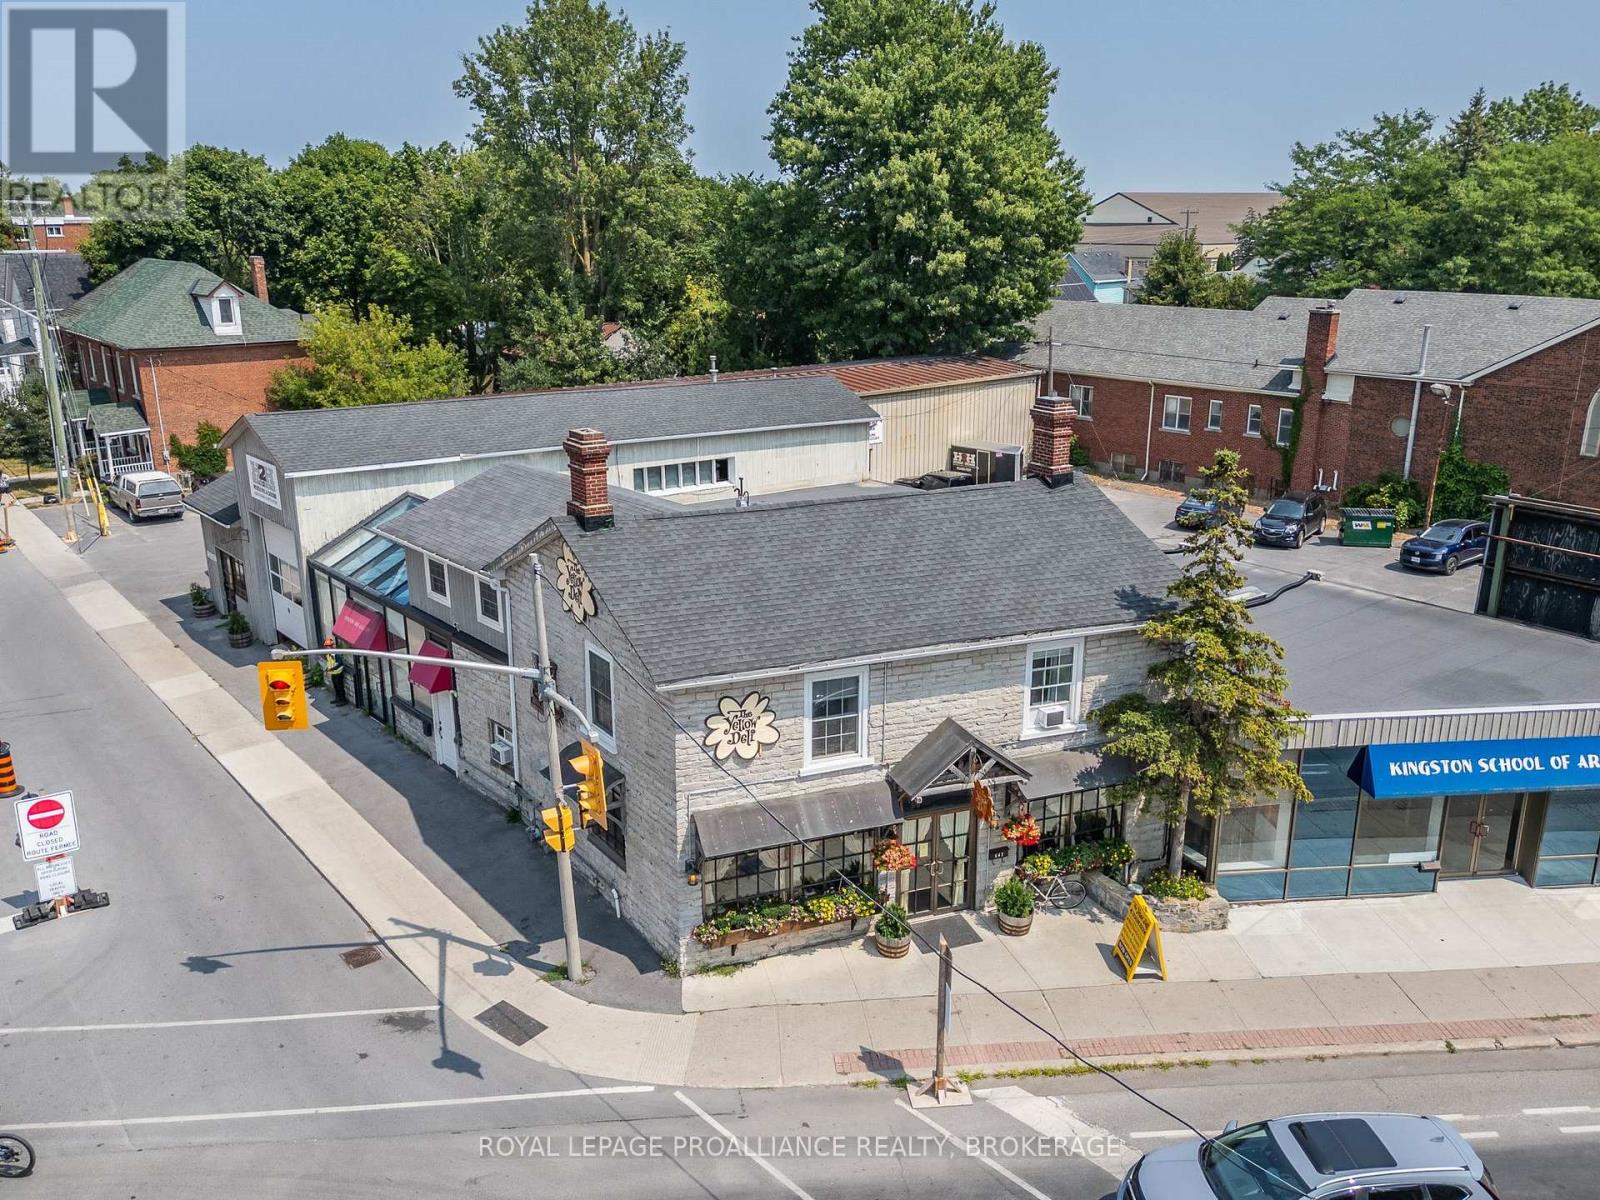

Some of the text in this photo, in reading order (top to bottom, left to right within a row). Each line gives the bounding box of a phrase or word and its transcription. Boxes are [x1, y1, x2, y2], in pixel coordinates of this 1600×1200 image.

[257, 464, 267, 481] 2
[568, 585, 583, 608] Deli
[727, 709, 753, 719] The
[723, 714, 761, 735] Yellow
[727, 729, 756, 746] Deli
[1389, 759, 1472, 776] KINGSTON
[1478, 756, 1545, 773] SCHOOL
[1550, 754, 1570, 770] OF
[36, 836, 64, 848] CLOSED
[39, 830, 58, 838] ROAD
[26, 847, 50, 856] ROUTE
